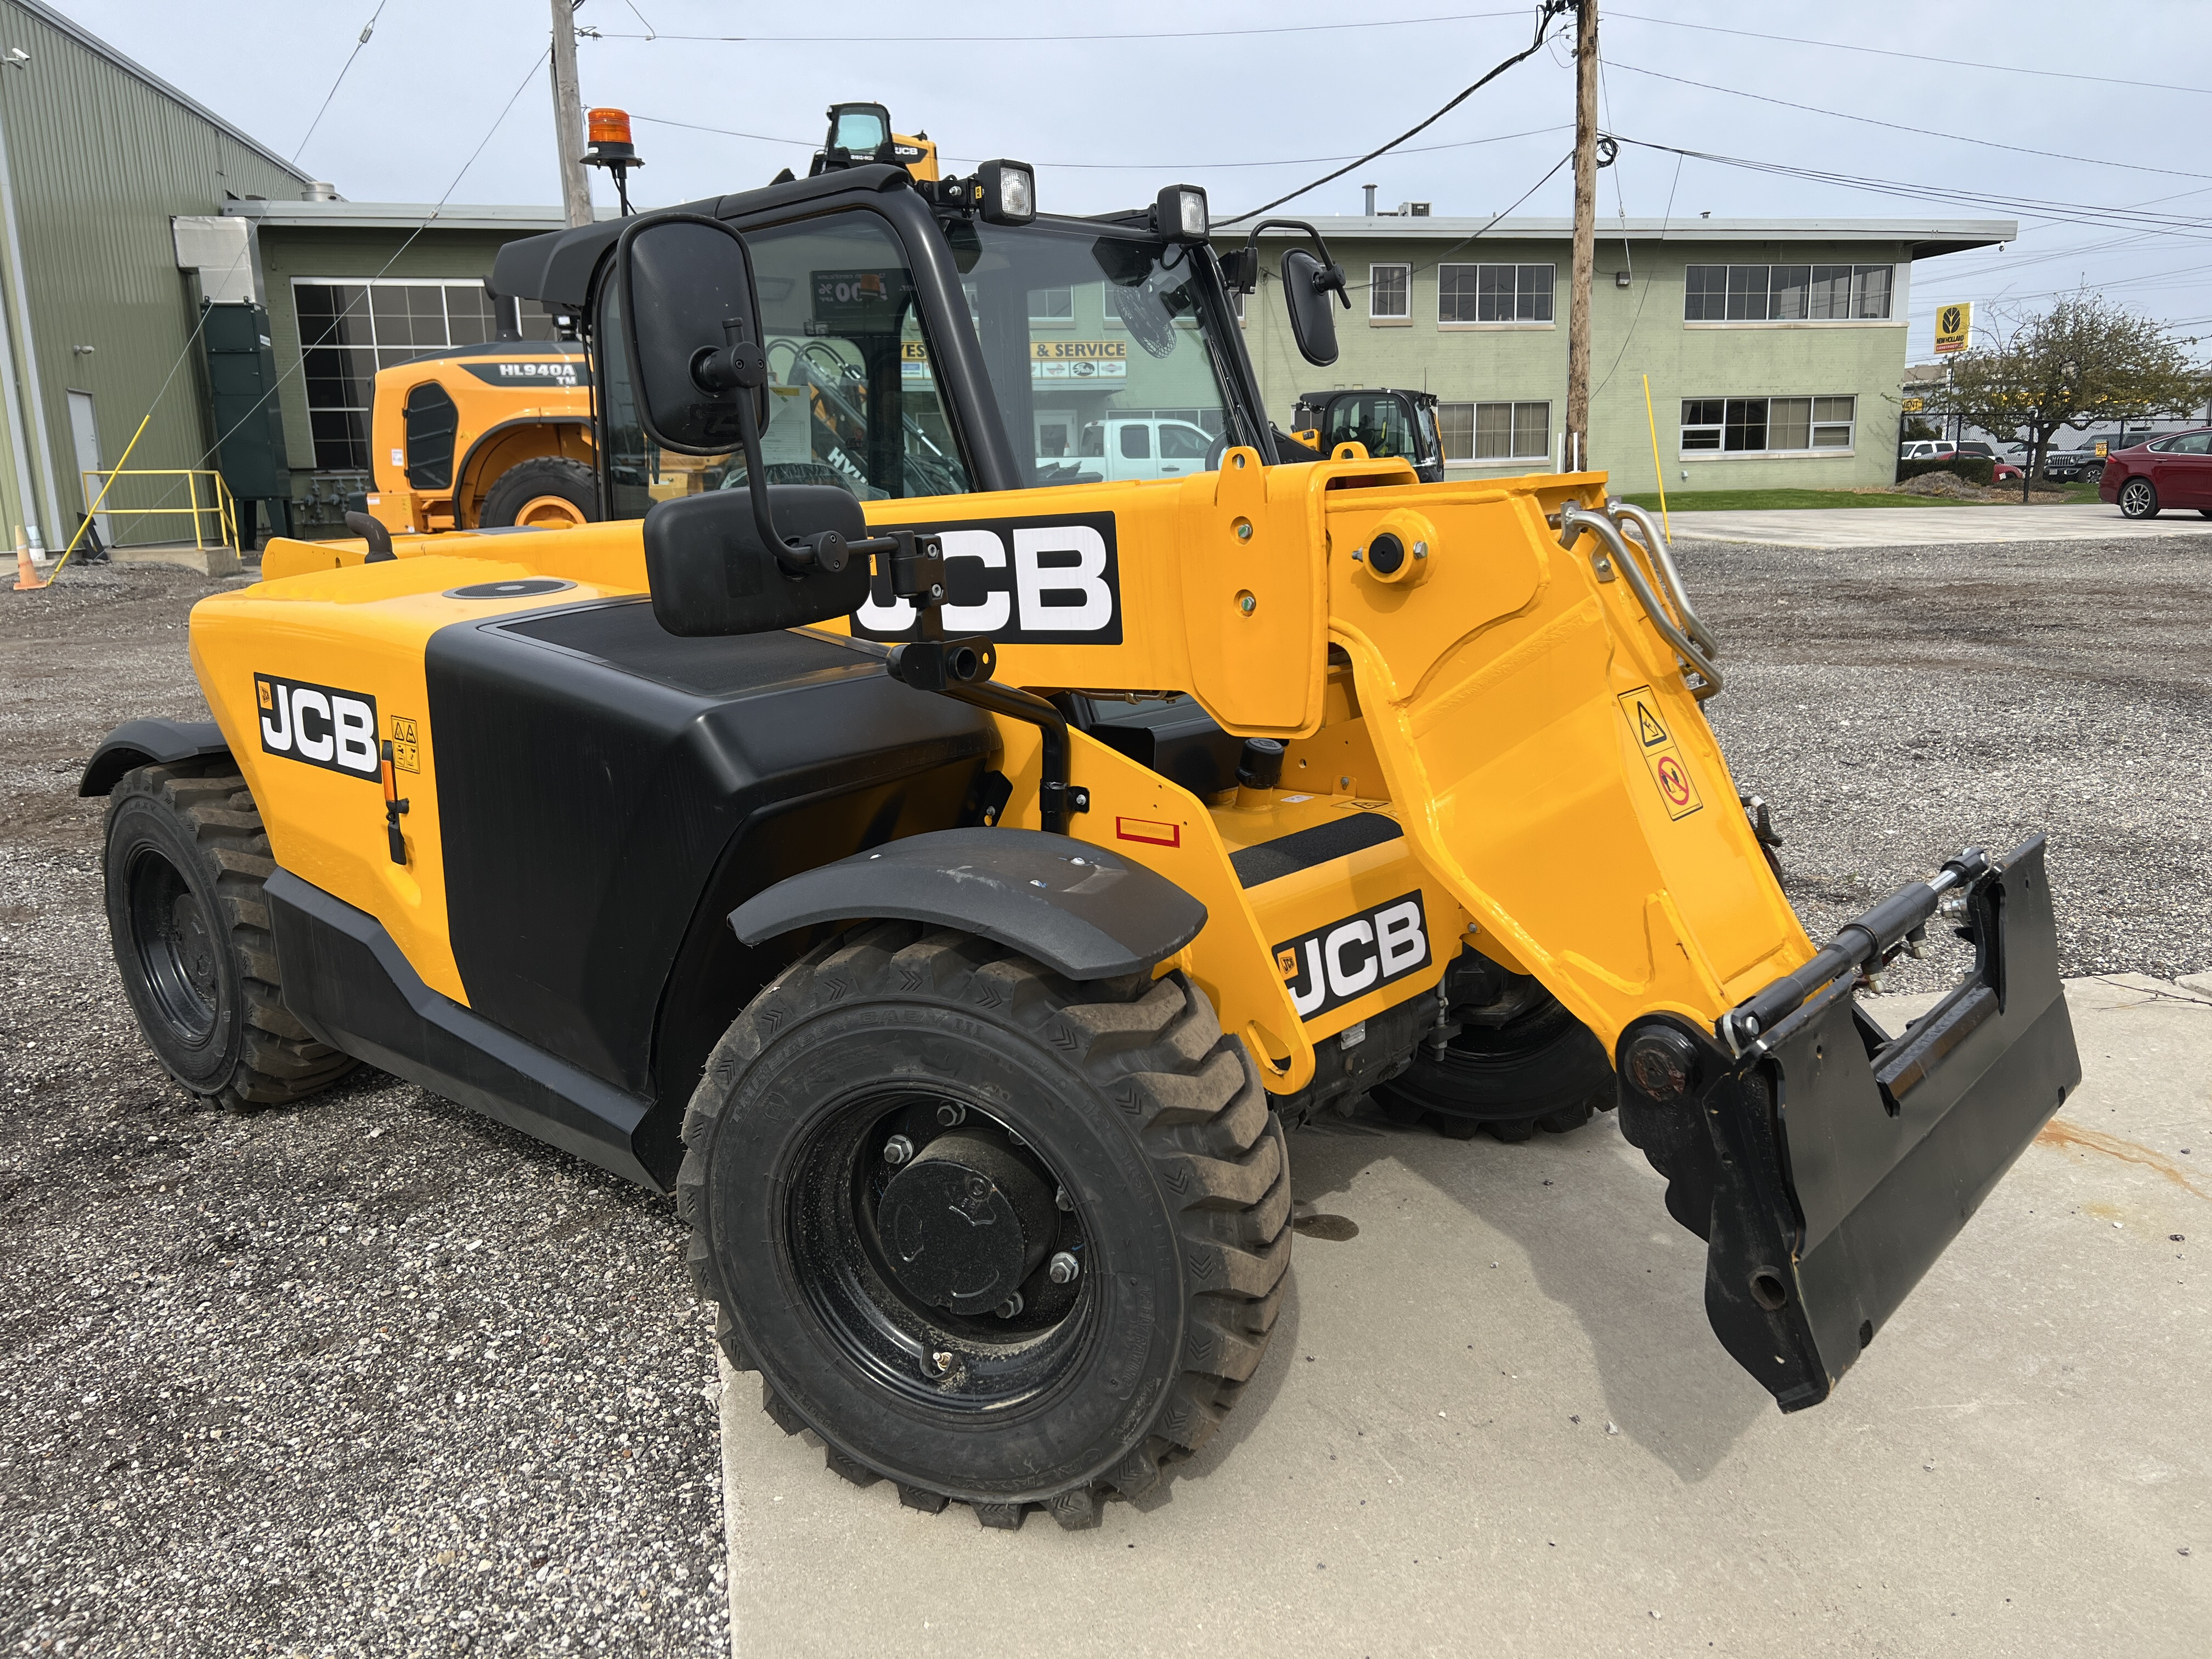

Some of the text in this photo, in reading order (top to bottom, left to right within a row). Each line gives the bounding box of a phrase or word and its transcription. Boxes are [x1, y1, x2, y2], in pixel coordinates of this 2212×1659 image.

[895, 146, 918, 155] JCB
[1945, 335, 1964, 343] HOLLAND
[1056, 343, 1125, 357] SERVICE
[499, 364, 575, 376] HL940A
[262, 684, 378, 773] JCB
[1283, 958, 1294, 972] JCB
[1288, 901, 1426, 1017] JCB
[768, 1016, 849, 1071] BEEFY
[859, 1009, 948, 1025] BABY
[1121, 1334, 1148, 1388] RATING
